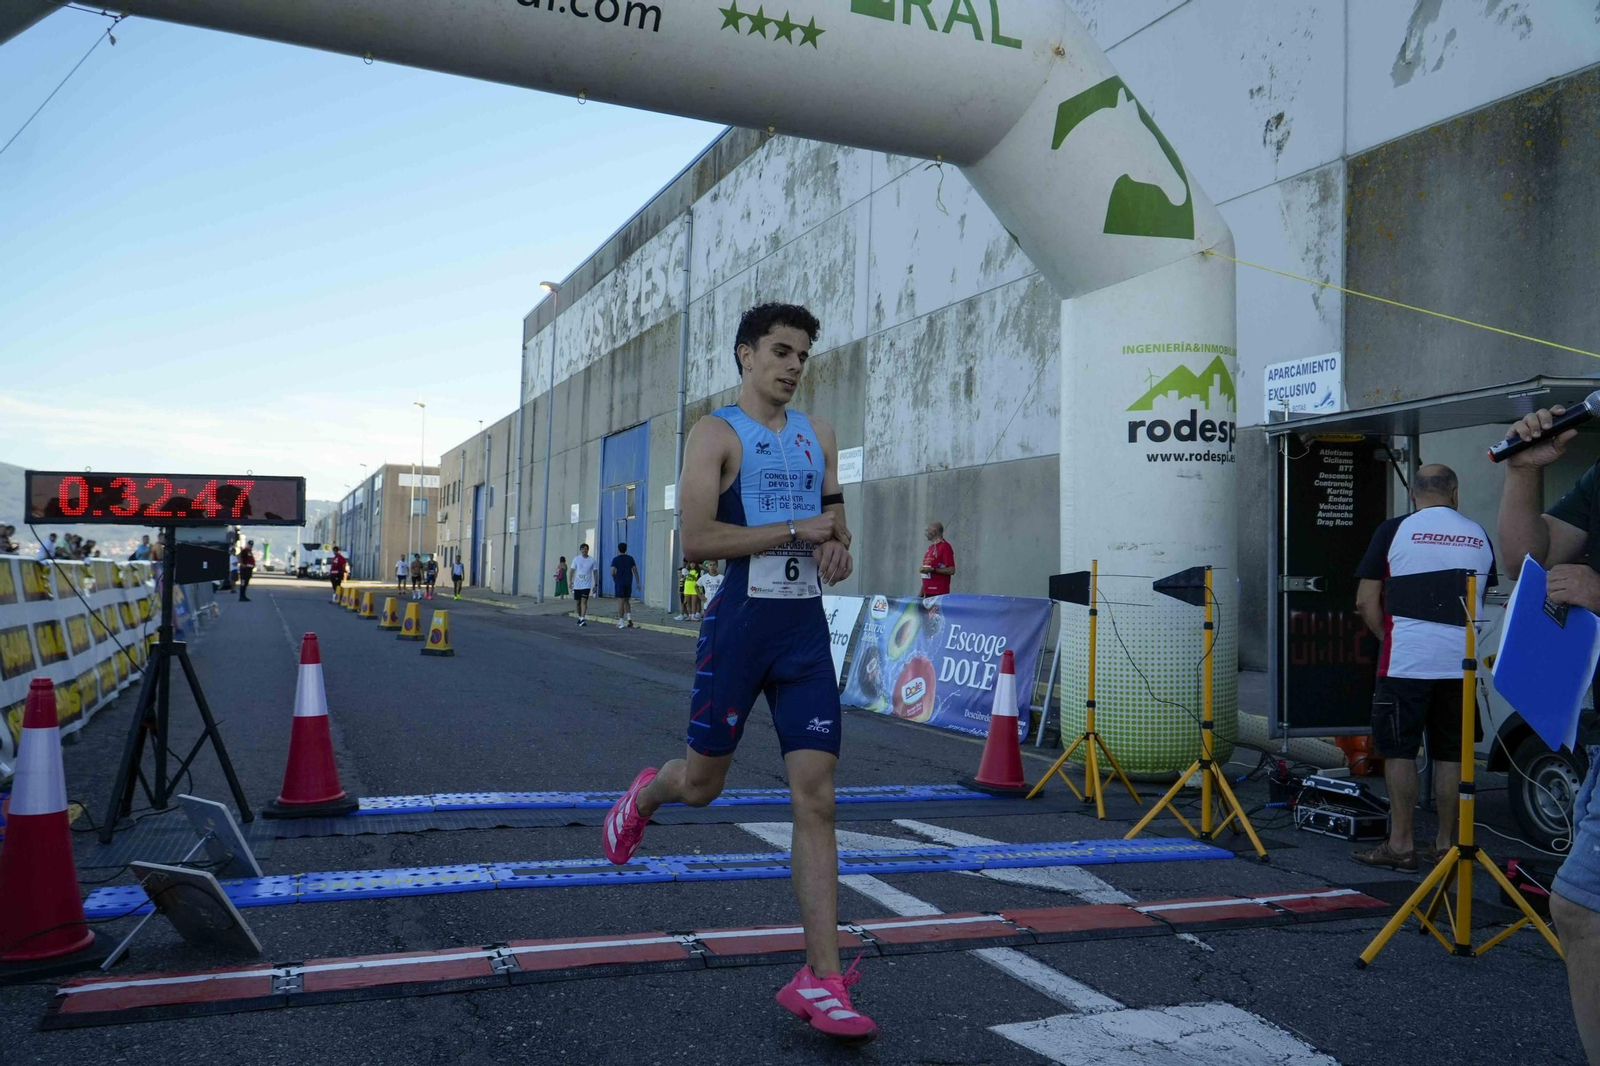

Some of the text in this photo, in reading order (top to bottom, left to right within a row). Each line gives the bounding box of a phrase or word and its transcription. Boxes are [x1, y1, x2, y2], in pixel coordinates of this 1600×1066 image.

[1268, 358, 1337, 381] APARCAMIENTO
[1268, 381, 1317, 401] EXCLUSIVO
[58, 475, 255, 517] 0:32:47
[1327, 487, 1354, 496] Karting
[779, 502, 791, 510] DE
[1319, 503, 1354, 511] Velocidad
[1317, 519, 1334, 527] Drag
[1411, 533, 1484, 547] CRONOTEC
[785, 557, 800, 582] 6
[945, 624, 1006, 662] Escoge
[939, 656, 997, 691] DOLE
[905, 681, 923, 698] Dole
[806, 724, 830, 734] ZICO
